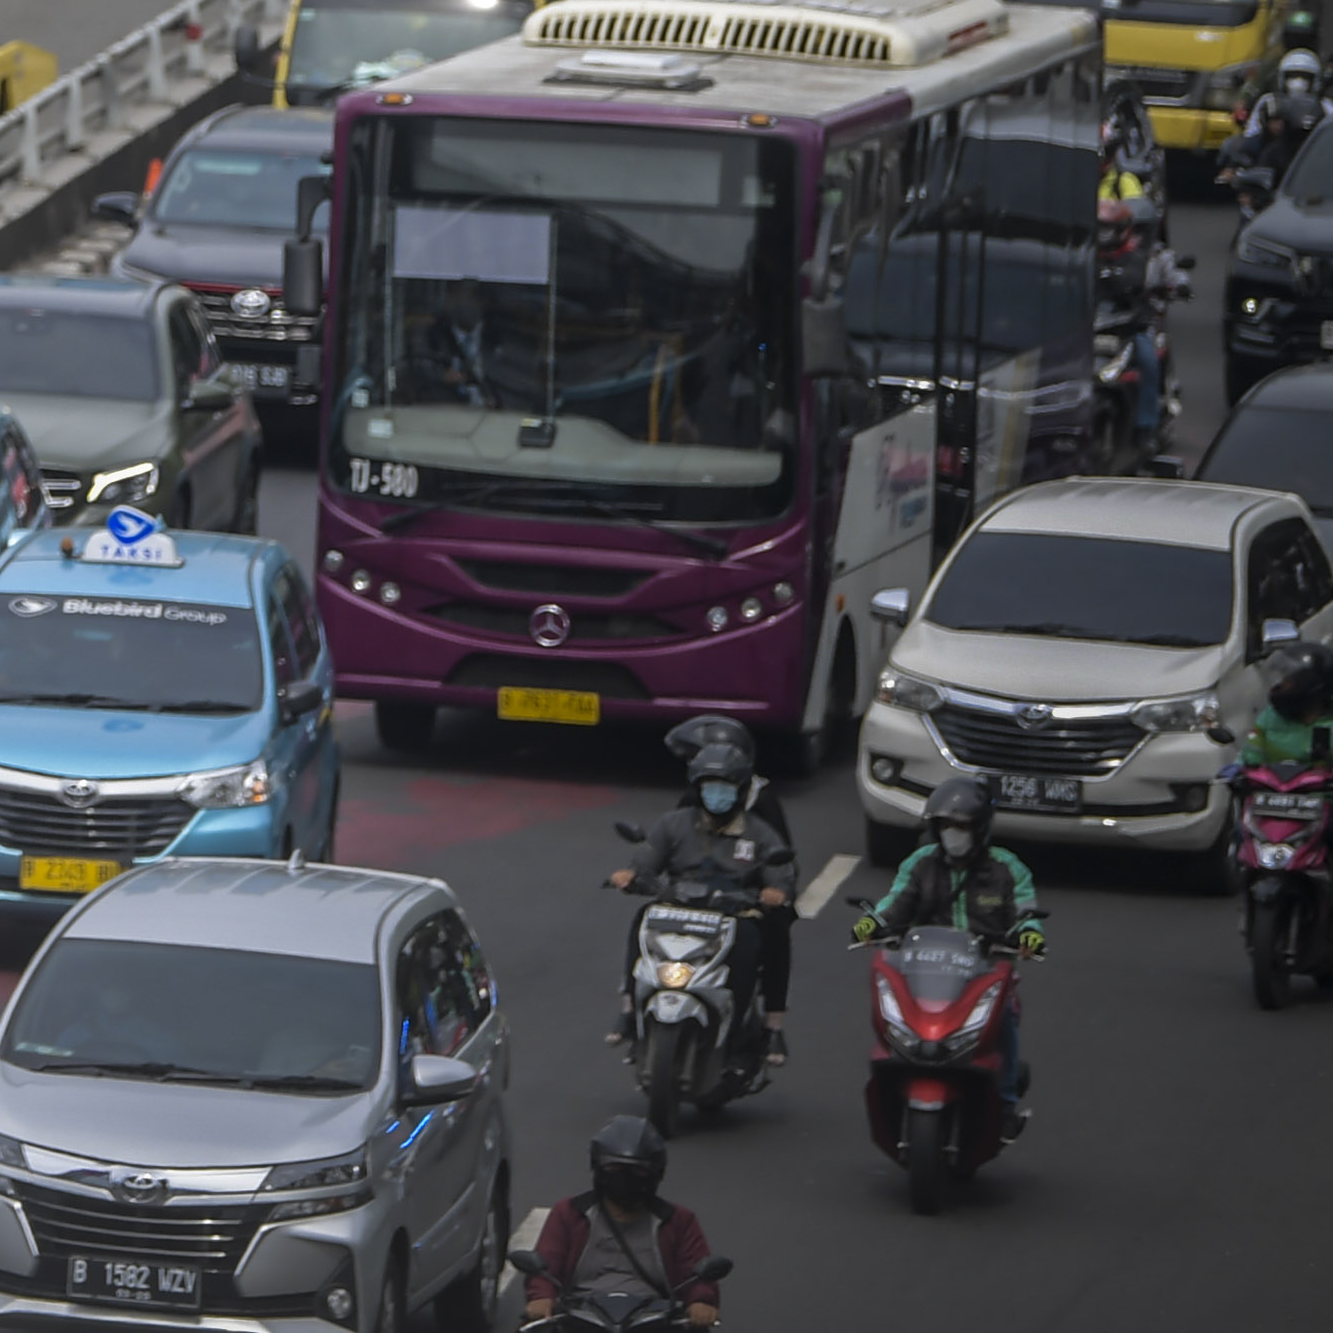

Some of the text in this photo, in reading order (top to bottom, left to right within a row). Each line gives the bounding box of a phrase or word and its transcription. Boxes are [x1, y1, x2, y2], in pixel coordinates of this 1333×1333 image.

[349, 457, 419, 498] TJ-580
[101, 544, 163, 559] TAKSI
[62, 598, 227, 625] Bluebird Group
[74, 1259, 196, 1293] B 1582 WZV
